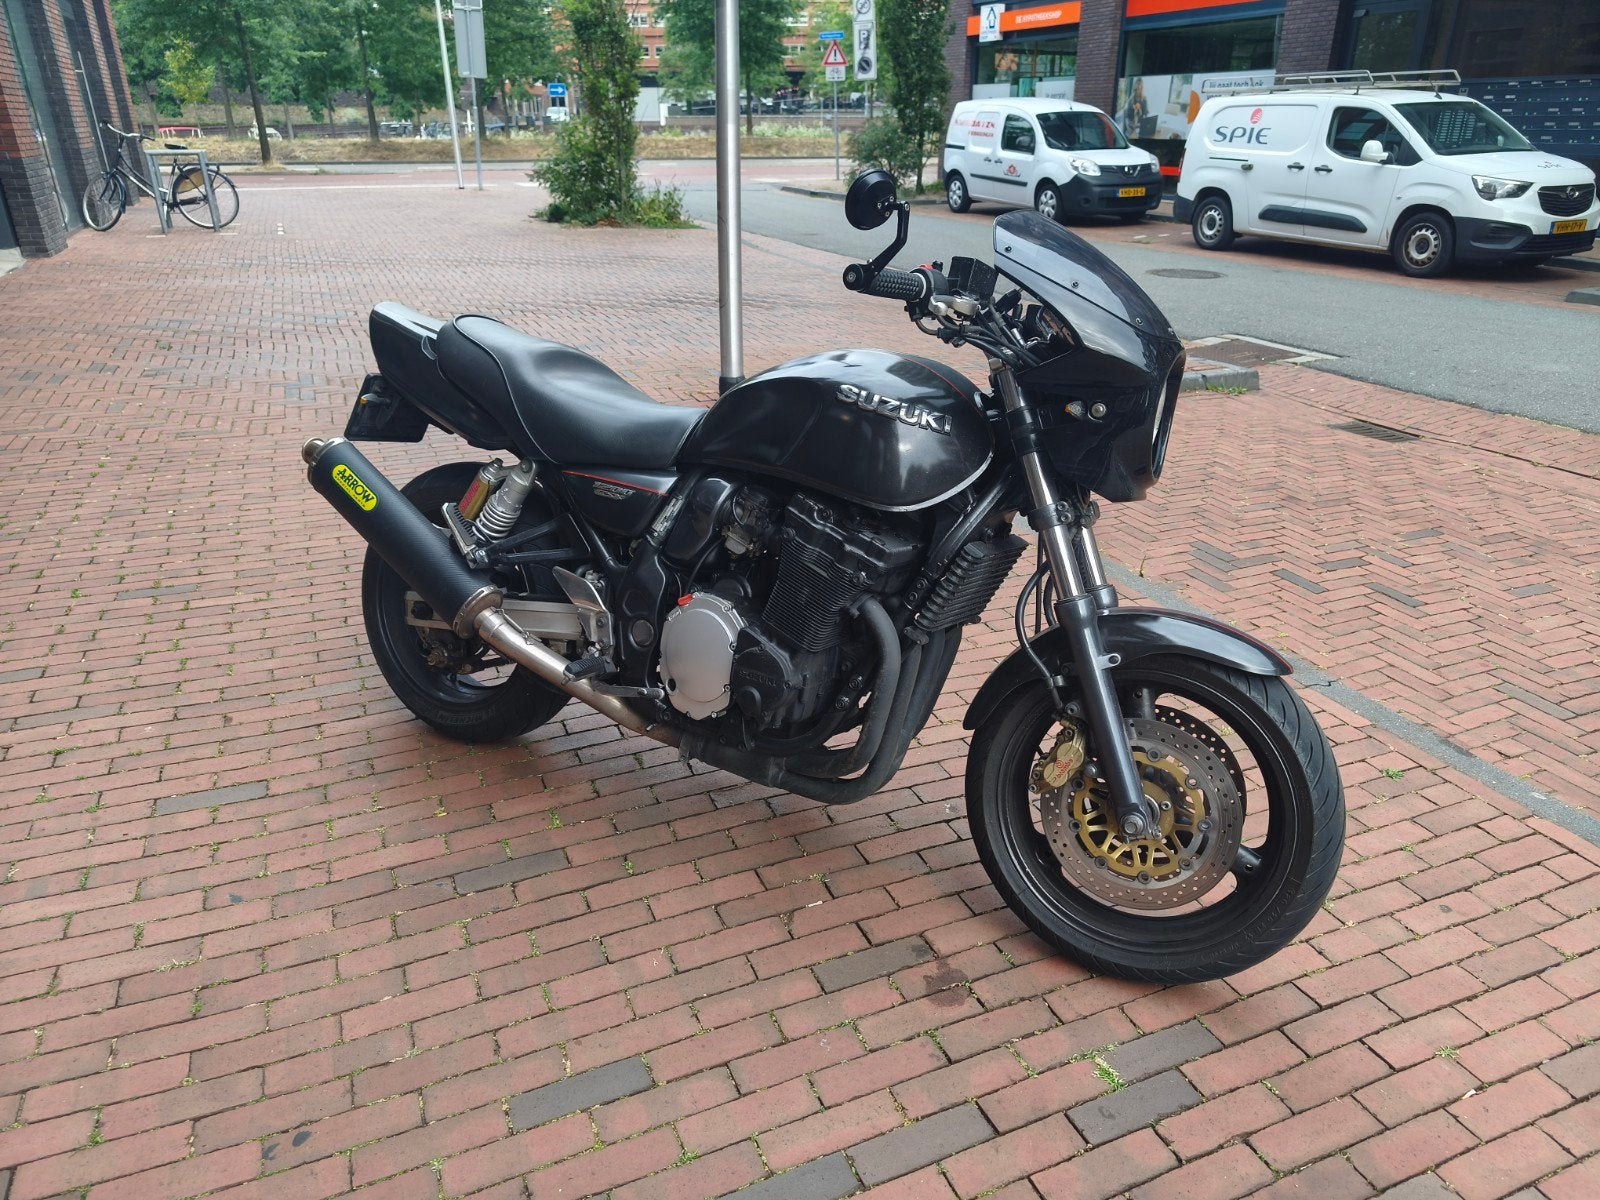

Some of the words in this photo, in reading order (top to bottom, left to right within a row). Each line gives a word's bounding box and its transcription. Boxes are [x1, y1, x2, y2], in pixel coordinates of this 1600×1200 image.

[1213, 126, 1272, 145] SPIE
[836, 384, 953, 437] SUZUKI
[336, 468, 375, 503] ARROW
